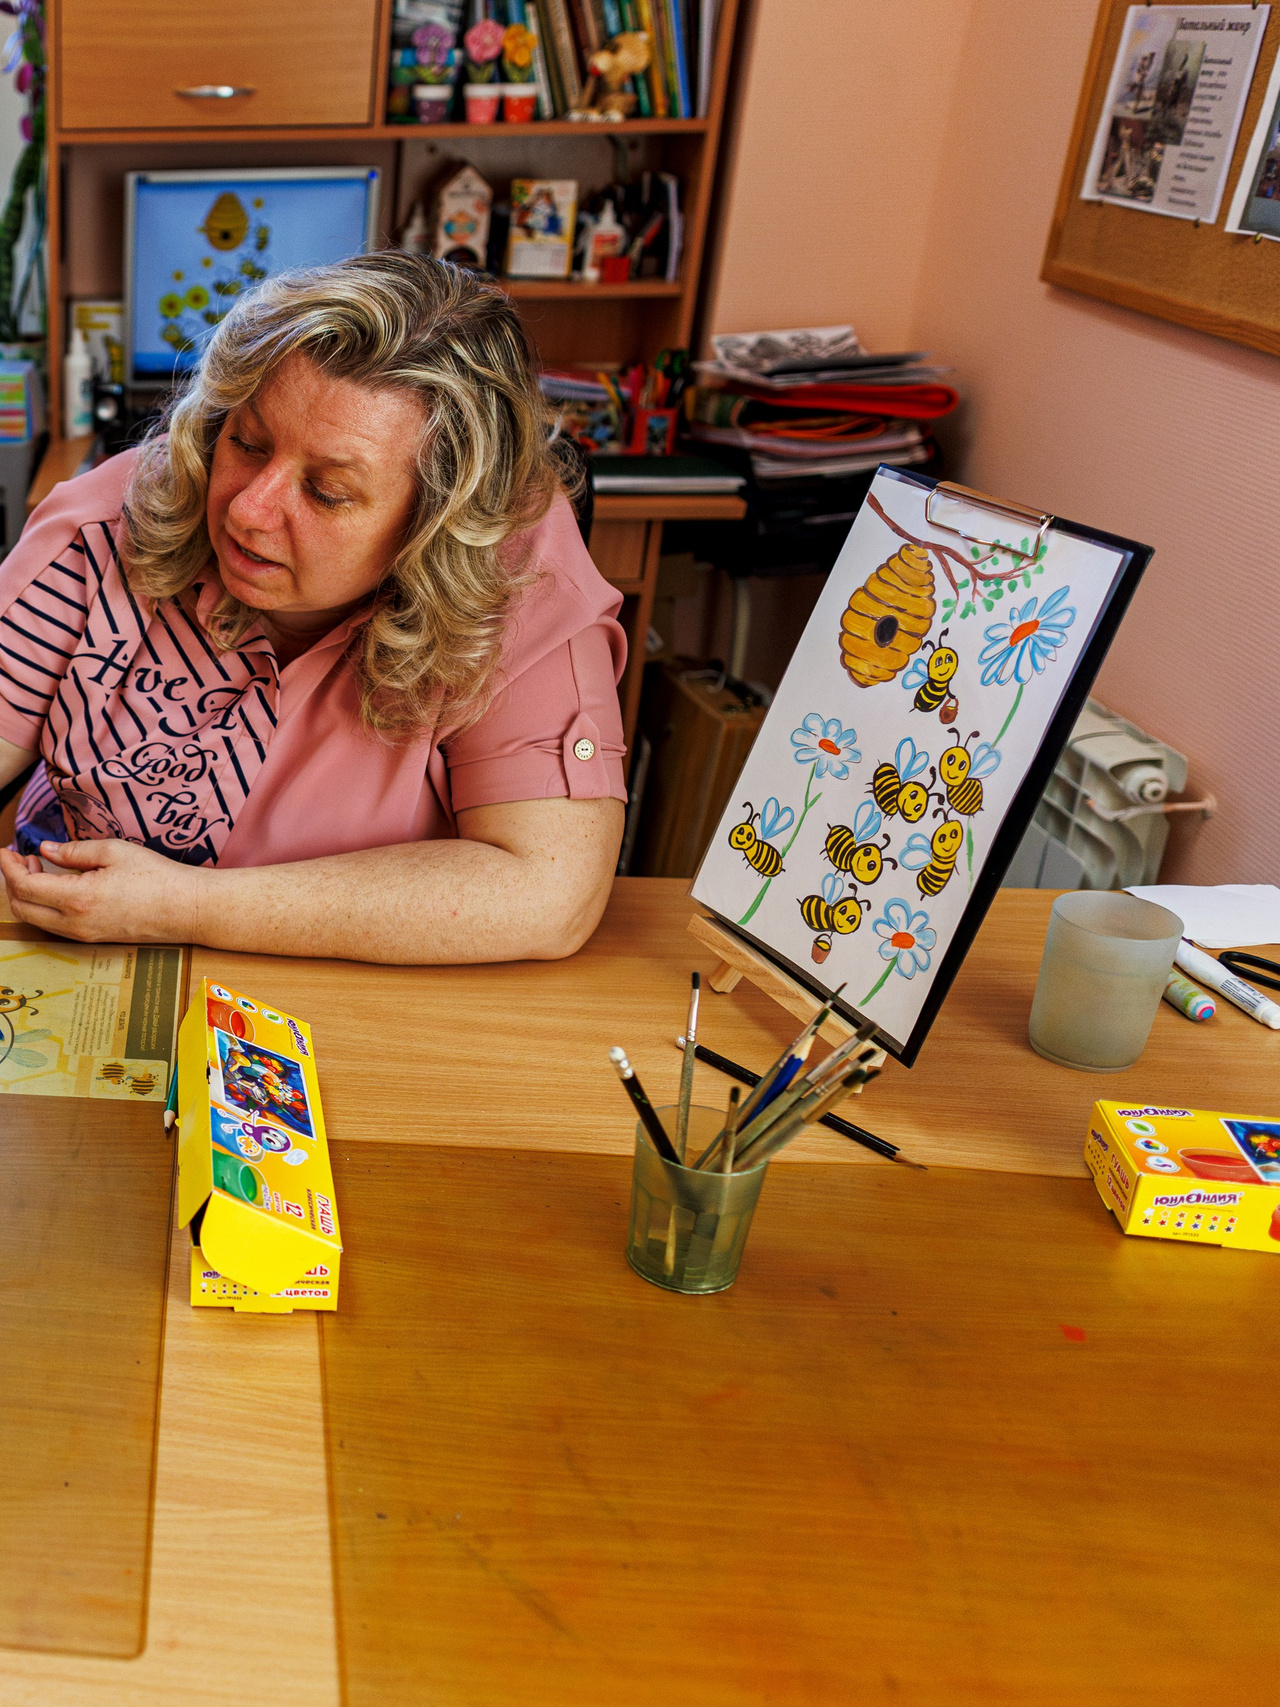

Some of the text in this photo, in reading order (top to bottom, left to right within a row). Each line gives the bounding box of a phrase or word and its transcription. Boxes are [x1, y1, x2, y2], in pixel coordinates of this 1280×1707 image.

[101, 742, 218, 787] Good
[285, 1201, 303, 1218] 12
[317, 1193, 334, 1235] ГУАШЬ
